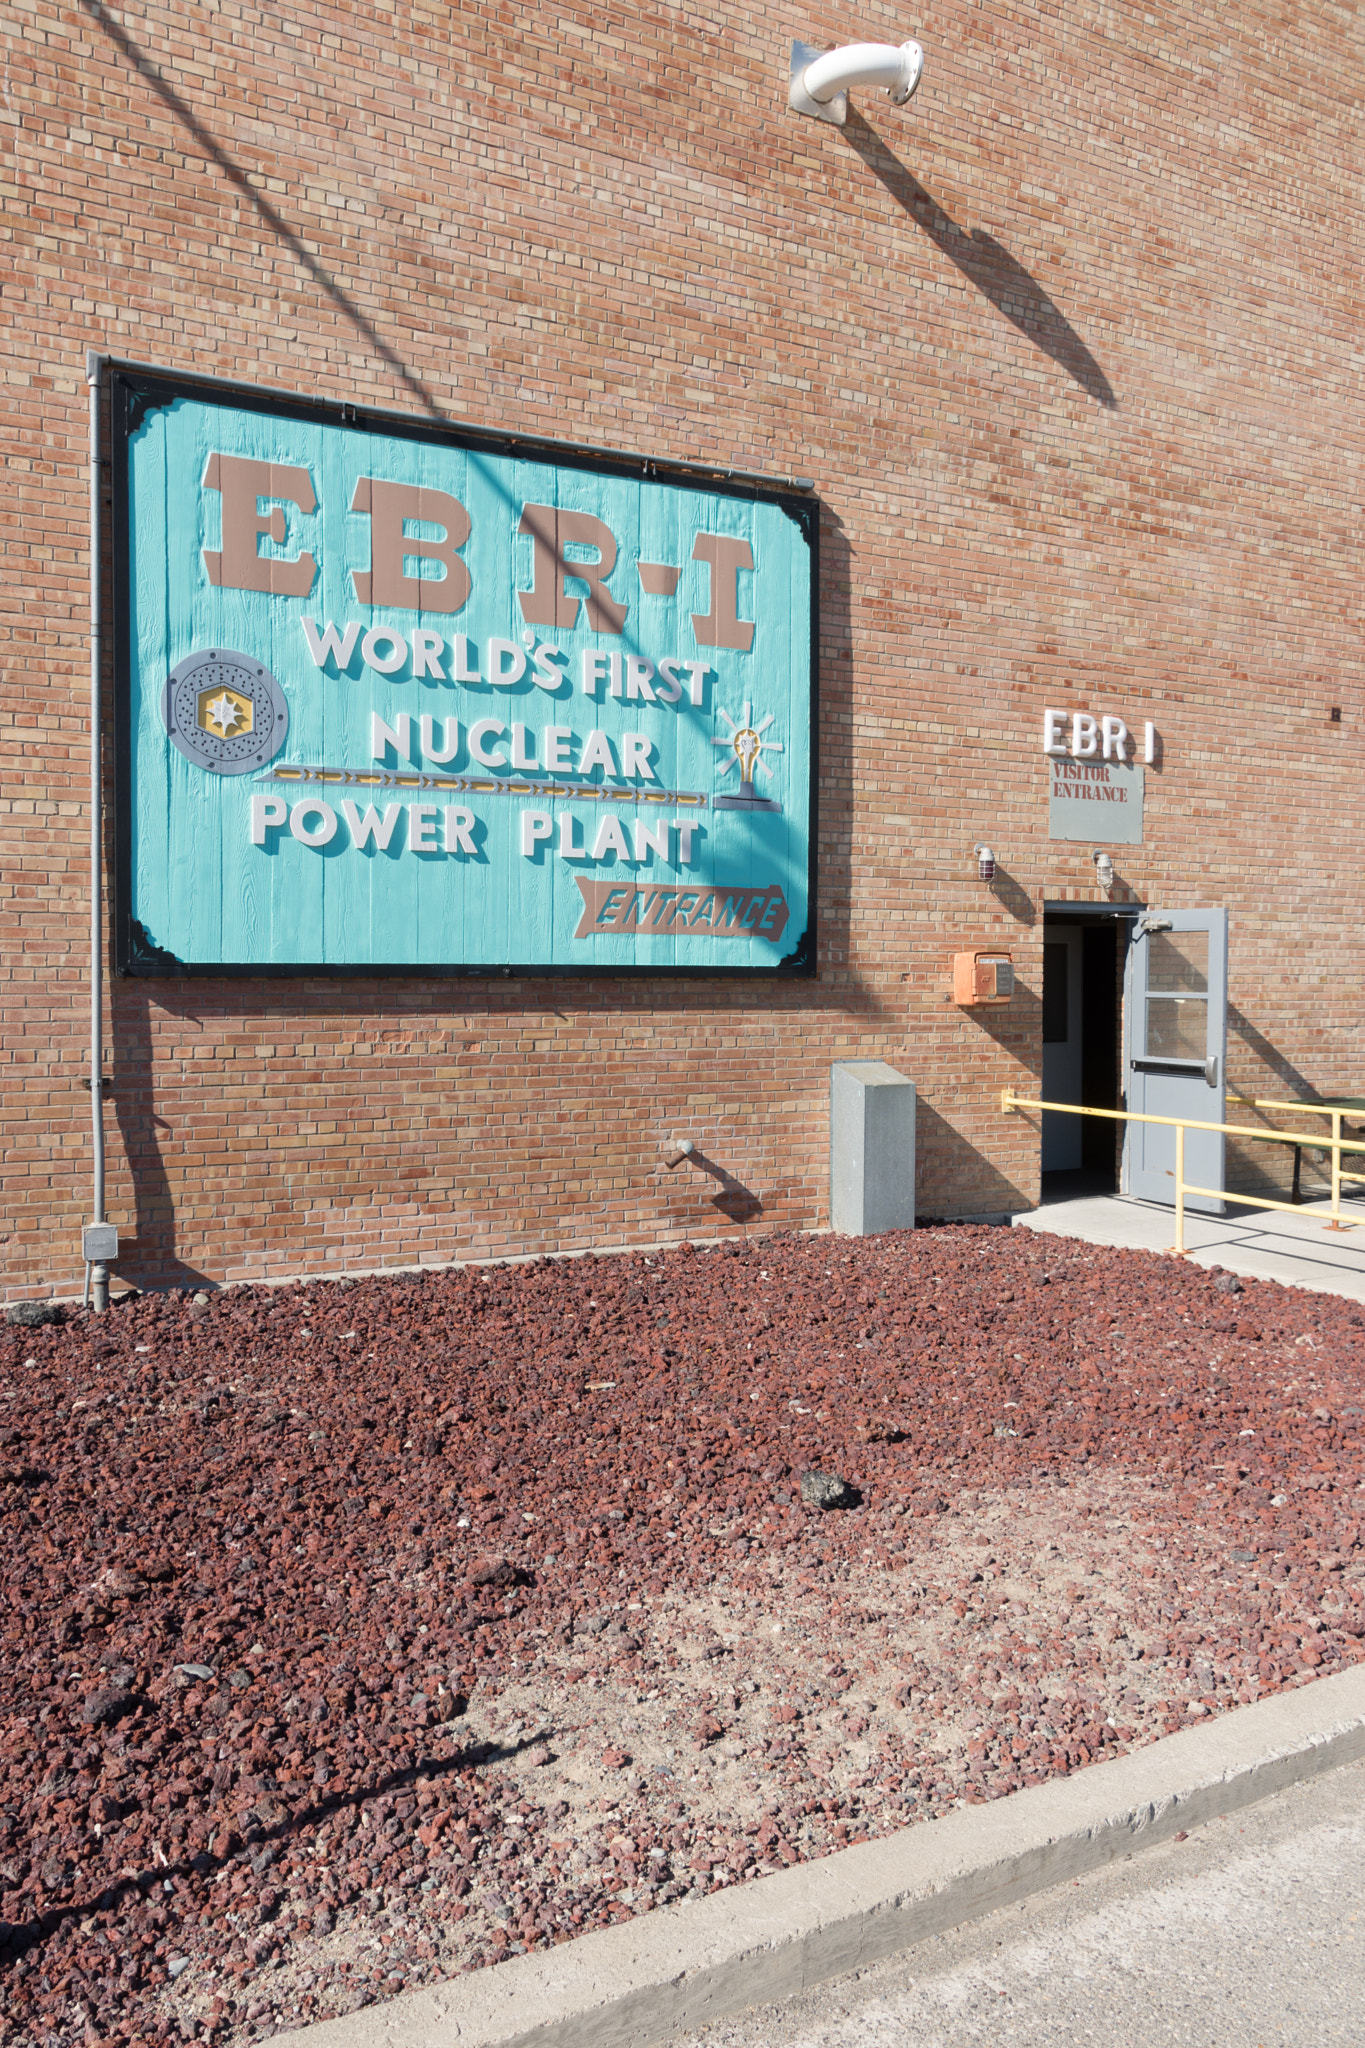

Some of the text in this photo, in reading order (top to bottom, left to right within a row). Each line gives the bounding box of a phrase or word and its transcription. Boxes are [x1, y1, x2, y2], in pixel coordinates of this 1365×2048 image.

[300, 616, 711, 706] WORLD'S FIRST
[372, 711, 655, 779] NUCLEAR
[1053, 762, 1110, 783] VISITOR
[1053, 782, 1128, 803] ENTRANCE
[252, 795, 699, 863] POWER PLANT
[595, 888, 785, 930] ENTRANCE
